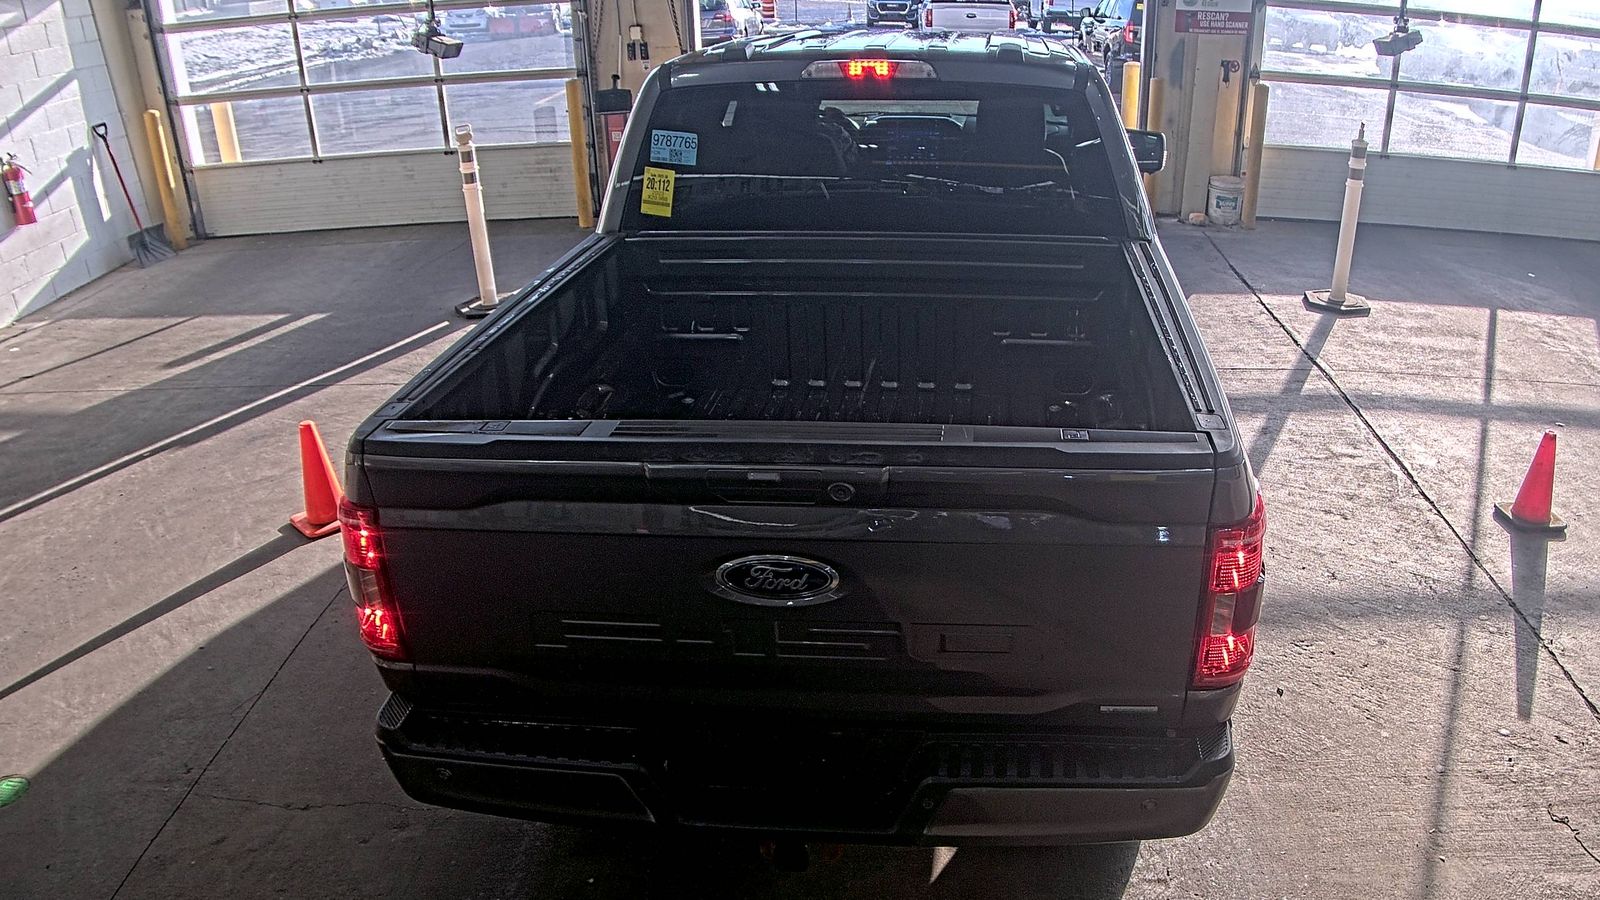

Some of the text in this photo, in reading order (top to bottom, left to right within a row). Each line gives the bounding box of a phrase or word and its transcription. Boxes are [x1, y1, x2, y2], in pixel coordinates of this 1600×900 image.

[1198, 12, 1229, 21] RESCAN?
[1225, 21, 1249, 29] SCANNER
[653, 133, 697, 150] 9787765
[646, 177, 671, 192] 20:112
[744, 565, 809, 590] Ford
